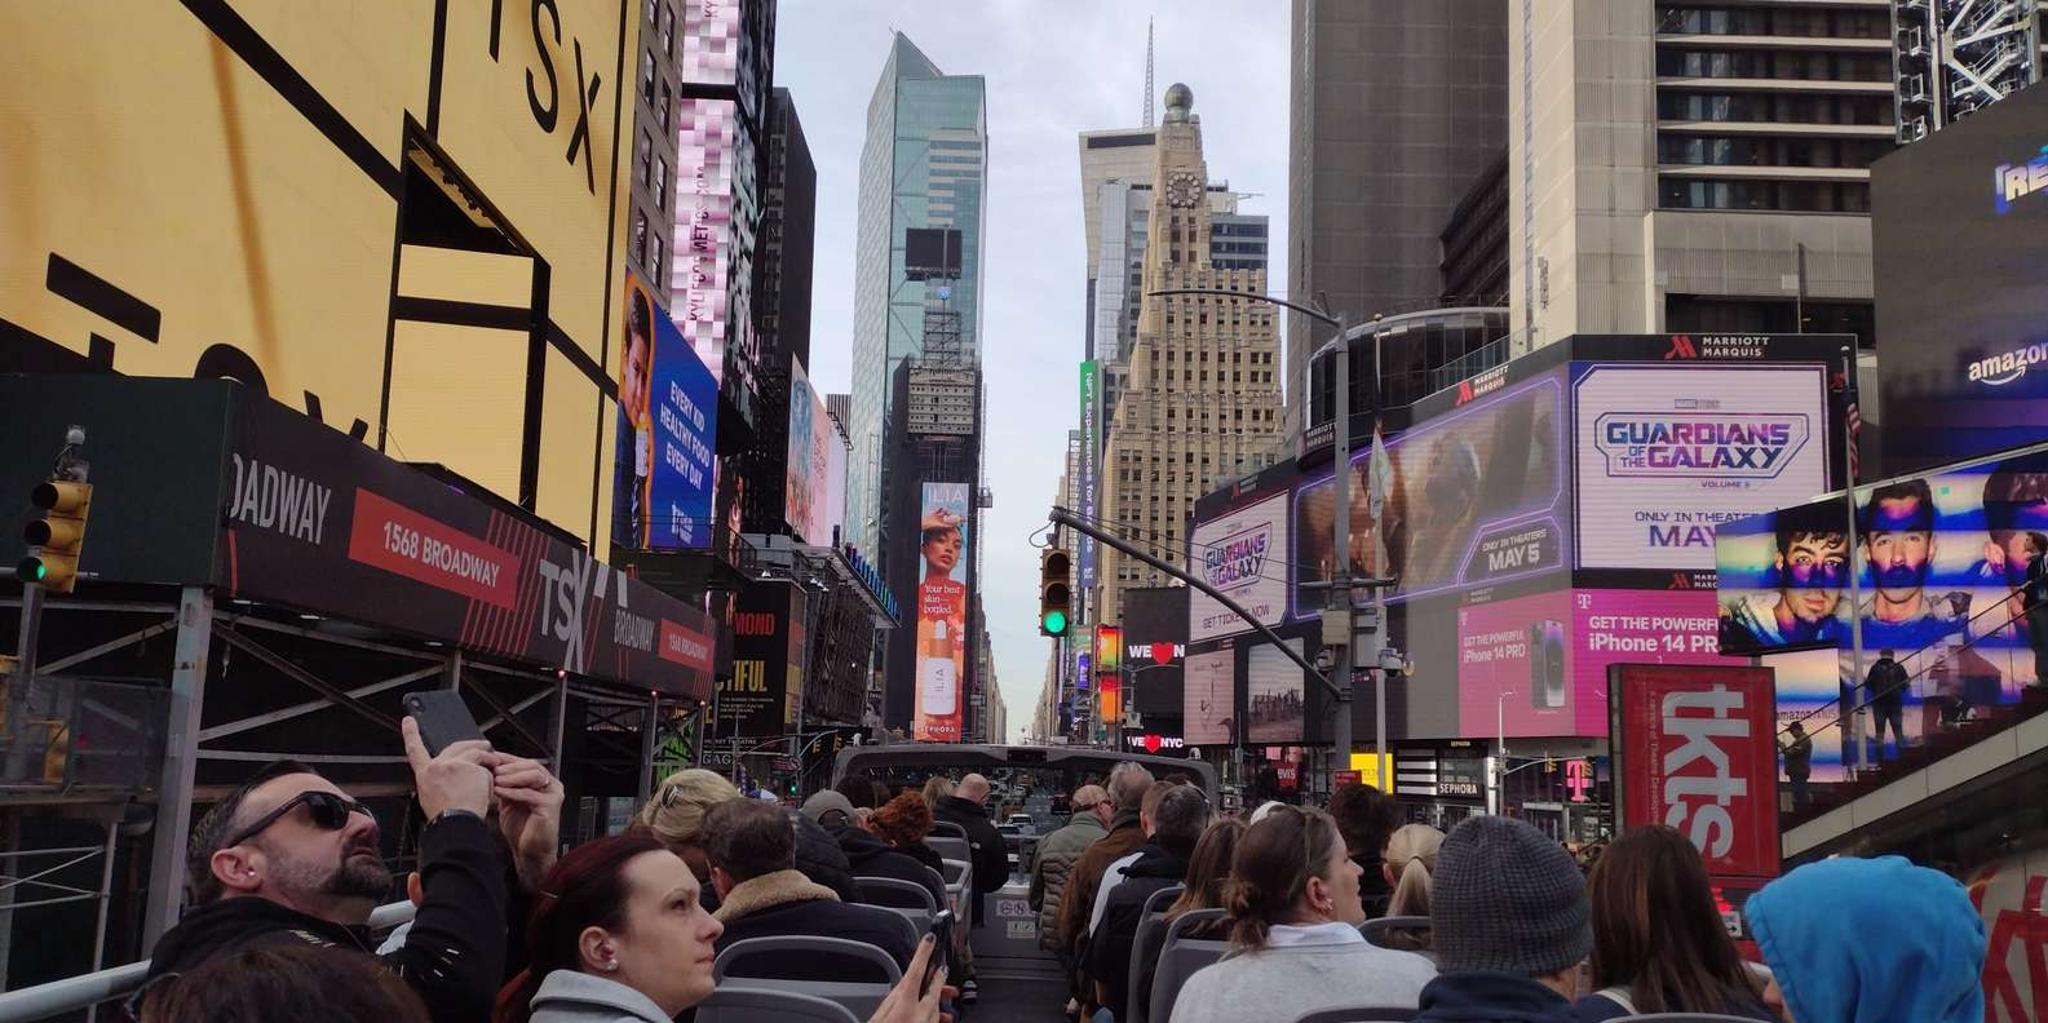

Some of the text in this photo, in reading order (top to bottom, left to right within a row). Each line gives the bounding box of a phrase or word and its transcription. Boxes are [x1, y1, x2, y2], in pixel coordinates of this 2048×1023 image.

[1702, 336, 1770, 346] MARRIOTT
[1702, 347, 1763, 357] MARQUIS
[1474, 365, 1509, 386] MARRIOTT
[1473, 376, 1506, 396] MARQUIS
[670, 380, 705, 433] EVERY KID
[660, 403, 710, 468] HEALTHY FOOD
[1606, 422, 1793, 445] GUARDIANS
[1620, 446, 1783, 469] THE GALAXY
[1629, 446, 1646, 457] OF
[666, 441, 703, 490] EVERY DAY
[1635, 511, 1669, 522] ONLY
[1674, 512, 1692, 522] IN
[383, 521, 500, 588] 1568 BROADWAY
[1206, 533, 1266, 569] GUARDIANS
[1489, 542, 1540, 571] MAY 5
[614, 609, 655, 652] BROADWAY
[1588, 616, 1617, 630] GET
[1620, 616, 1649, 630] THE
[1128, 644, 1152, 658] WE
[1505, 643, 1526, 659] PRO
[1588, 632, 1658, 652] iPhone
[1661, 634, 1686, 652] 14
[1160, 737, 1184, 748] NYC
[1662, 683, 1750, 858] tkts
[1440, 783, 1478, 795] SEPHORA
